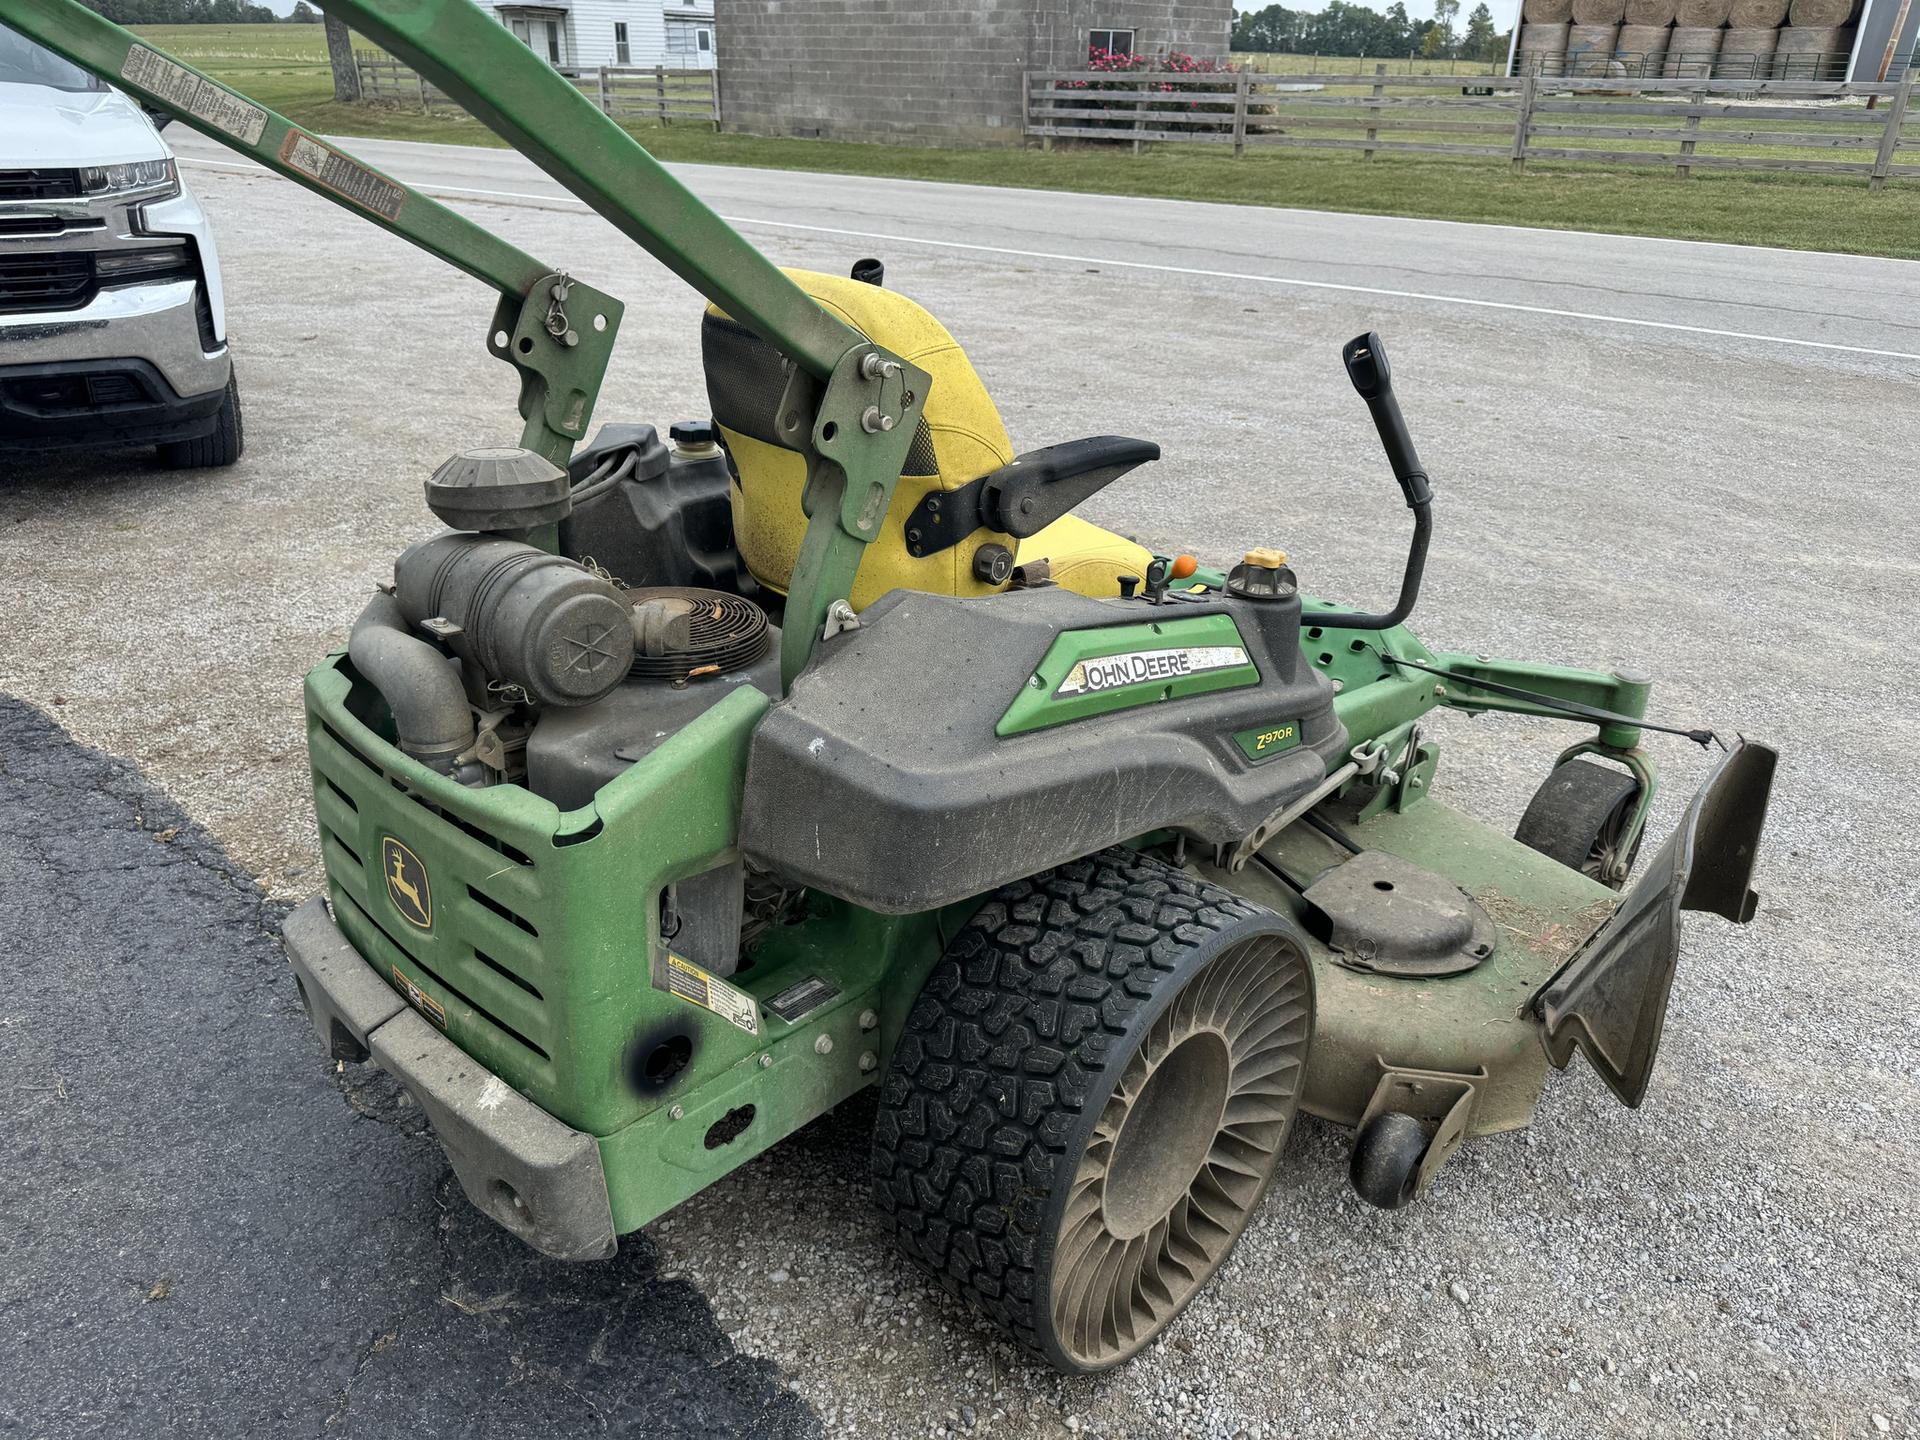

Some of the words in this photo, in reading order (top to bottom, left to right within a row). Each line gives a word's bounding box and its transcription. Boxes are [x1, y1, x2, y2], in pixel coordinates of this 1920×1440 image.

[1079, 662, 1131, 689] JOHN
[1131, 653, 1191, 679] DEERE
[1256, 726, 1293, 750] Z970R
[676, 961, 699, 978] CAUTION
